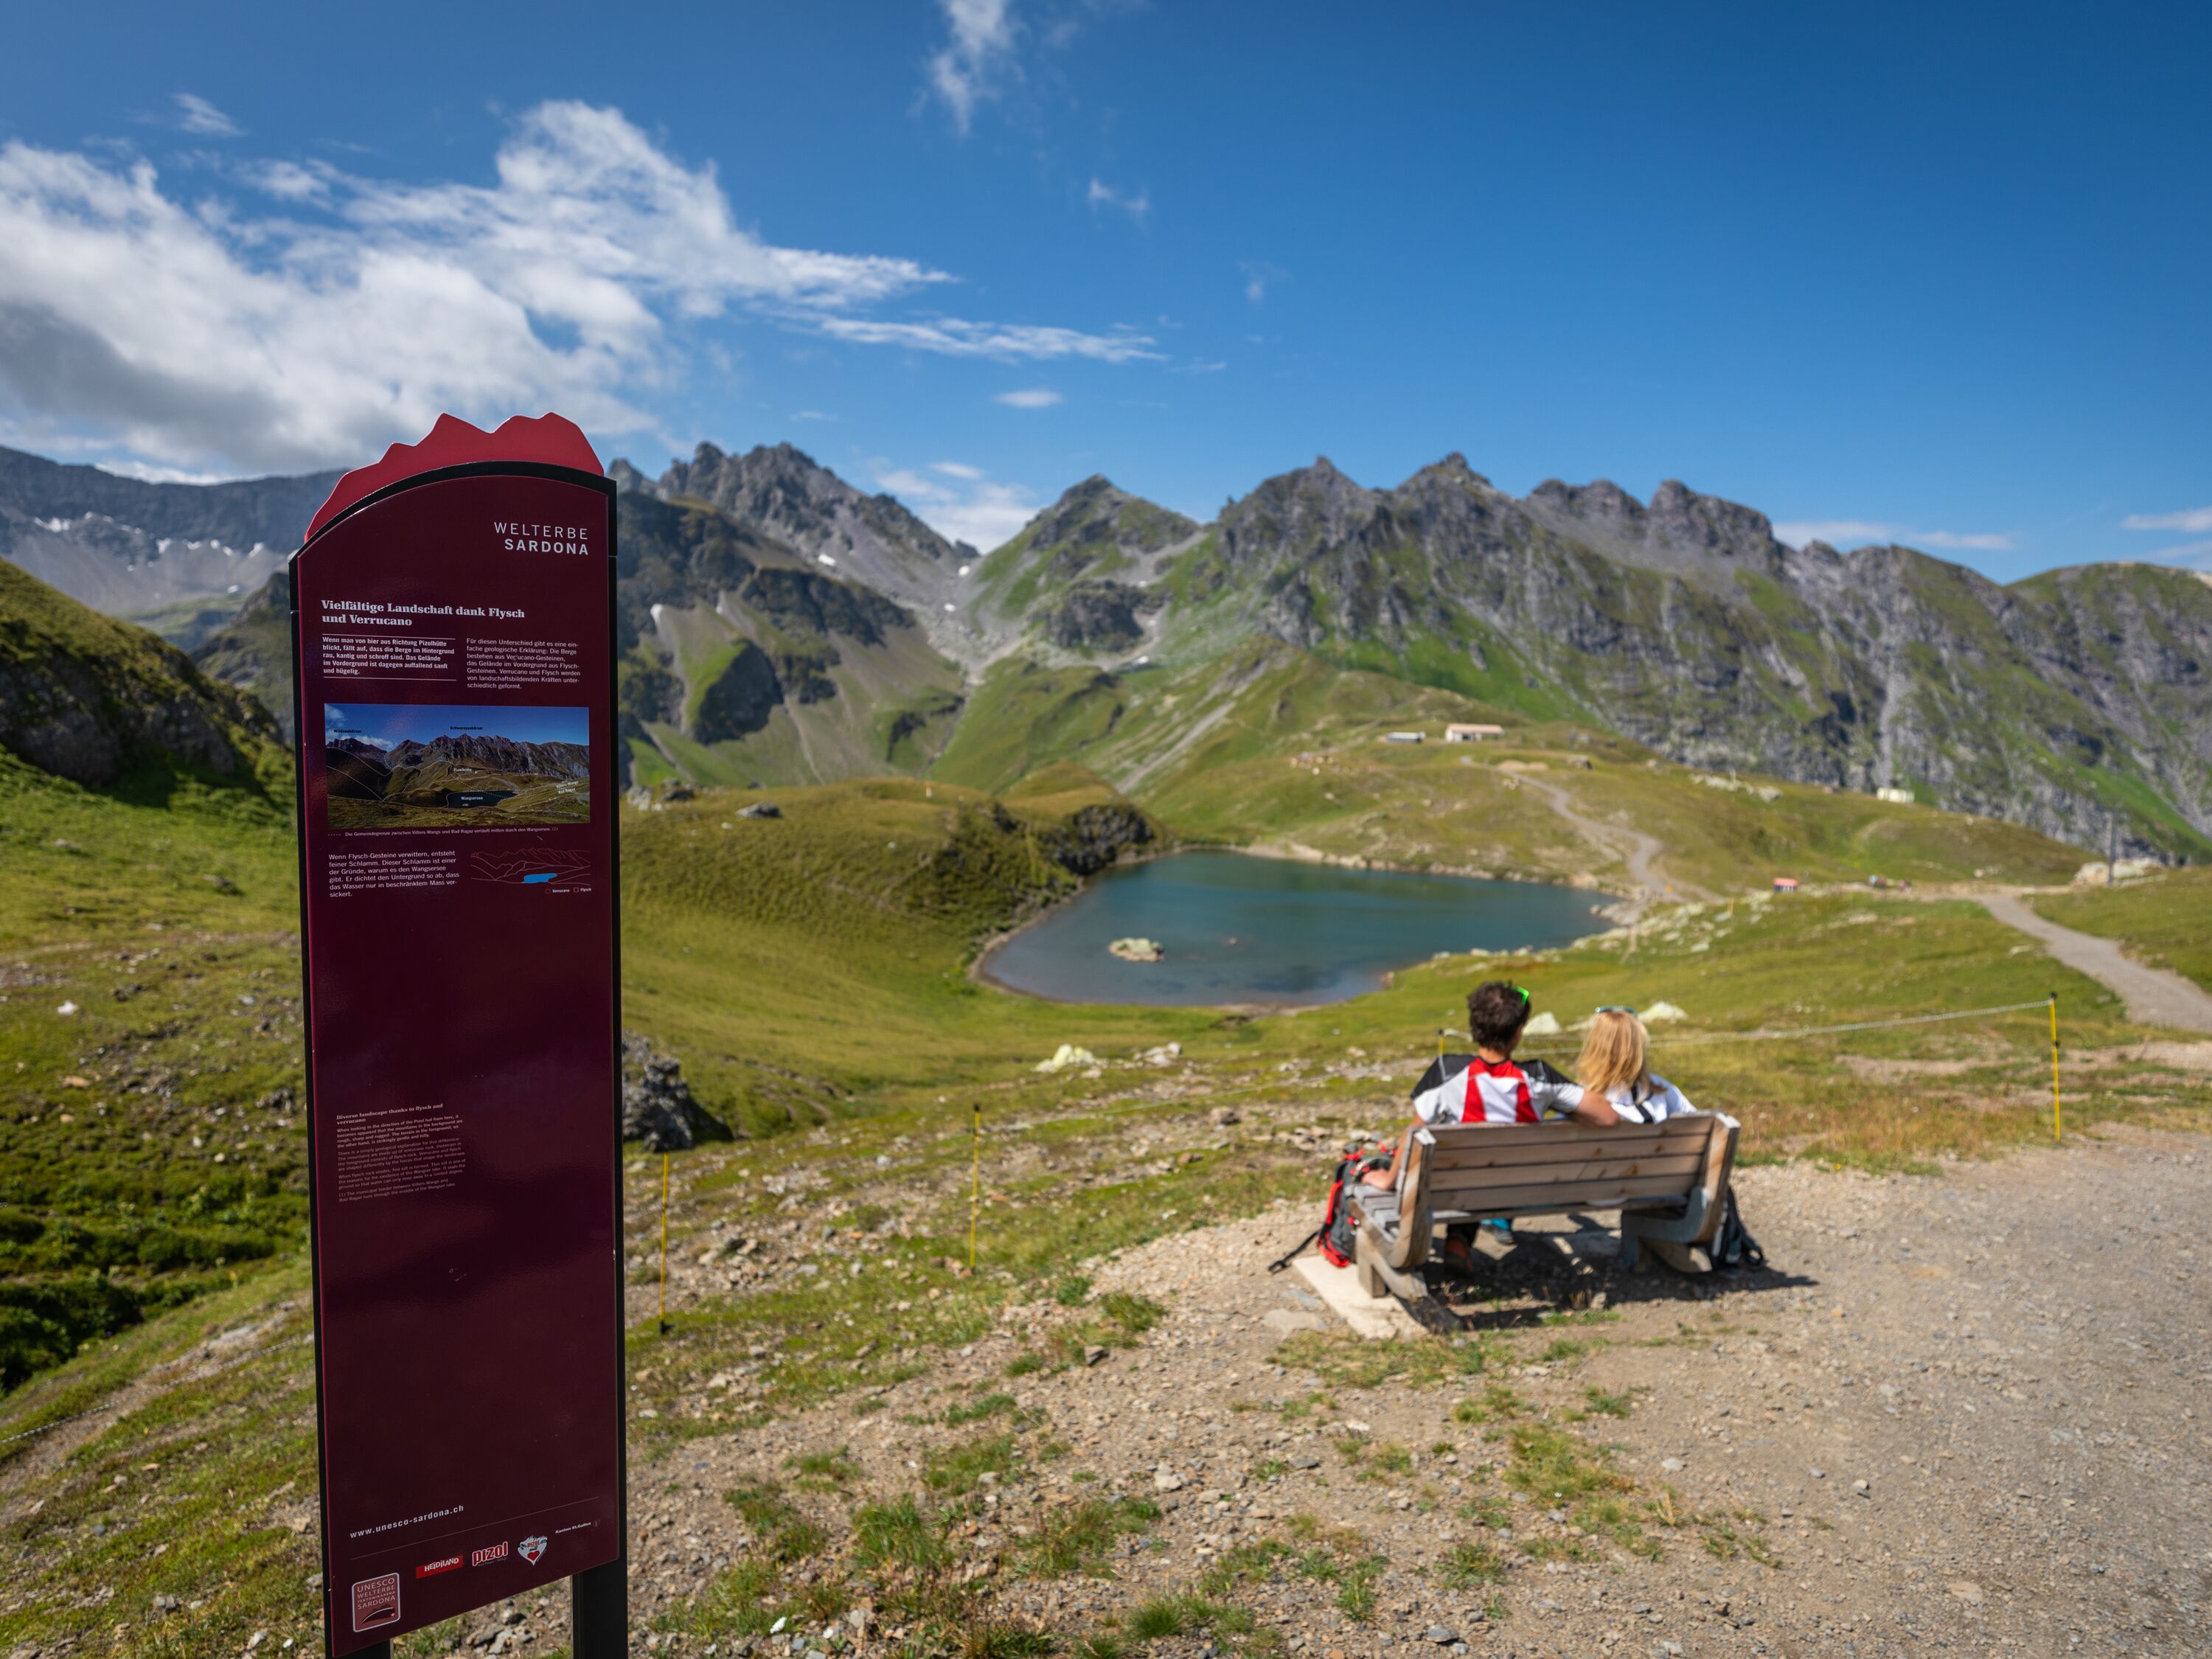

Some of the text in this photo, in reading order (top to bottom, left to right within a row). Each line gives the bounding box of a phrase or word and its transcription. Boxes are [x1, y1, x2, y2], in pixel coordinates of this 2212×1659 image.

[494, 522, 588, 540] WELTERBE
[505, 538, 588, 555] SARDONA
[321, 600, 525, 619] Vielfältige Landschaft dank Flysch
[322, 614, 412, 626] und Verrucano
[350, 1505, 463, 1538] www.unesco-sardona.ch
[357, 1577, 395, 1592] UNESCO
[357, 1585, 395, 1599] WELTERBE
[358, 1591, 395, 1603] TEKTONIKARENA
[358, 1595, 395, 1610] SARDONA
